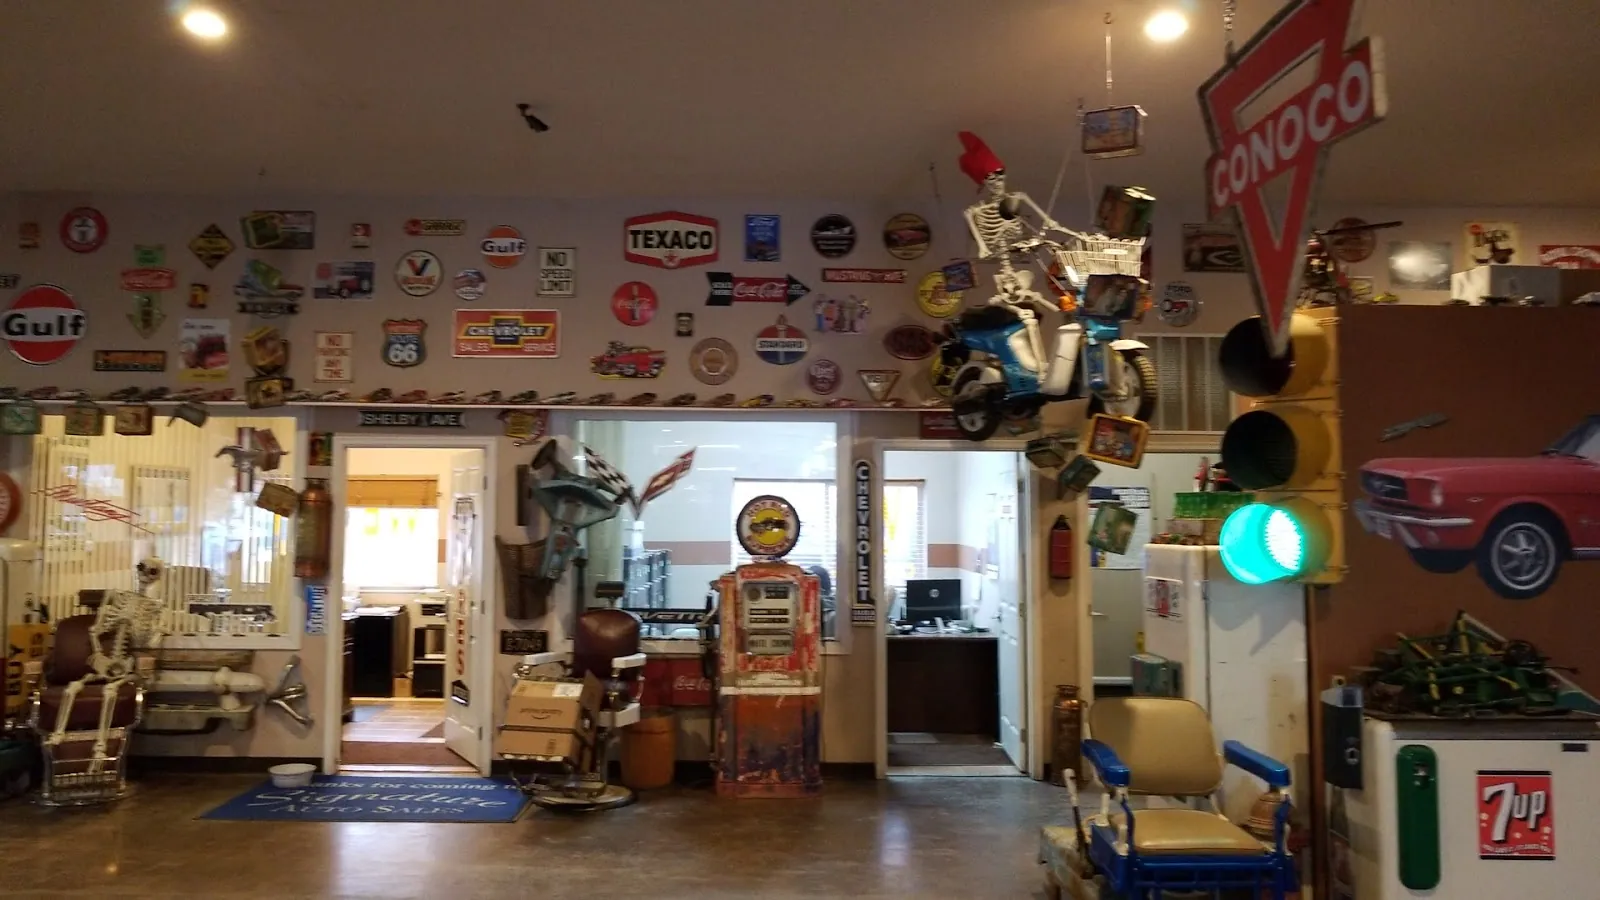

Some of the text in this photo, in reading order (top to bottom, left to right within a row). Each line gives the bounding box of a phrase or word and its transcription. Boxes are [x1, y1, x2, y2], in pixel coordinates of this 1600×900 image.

[1212, 60, 1370, 207] CONOCO
[481, 239, 526, 254] Gulf
[629, 229, 713, 250] TEXACO
[546, 252, 567, 267] NO
[540, 268, 573, 279] SPEED
[540, 279, 573, 292] LIMIT
[4, 312, 85, 337] Gulf
[467, 326, 545, 337] CHEVROLET
[388, 343, 419, 363] 66
[459, 342, 491, 352] SALES
[363, 412, 458, 426] SHELBY AVE
[856, 465, 872, 602] CHEVROLET
[408, 782, 498, 791] coming
[247, 788, 508, 809] Signature
